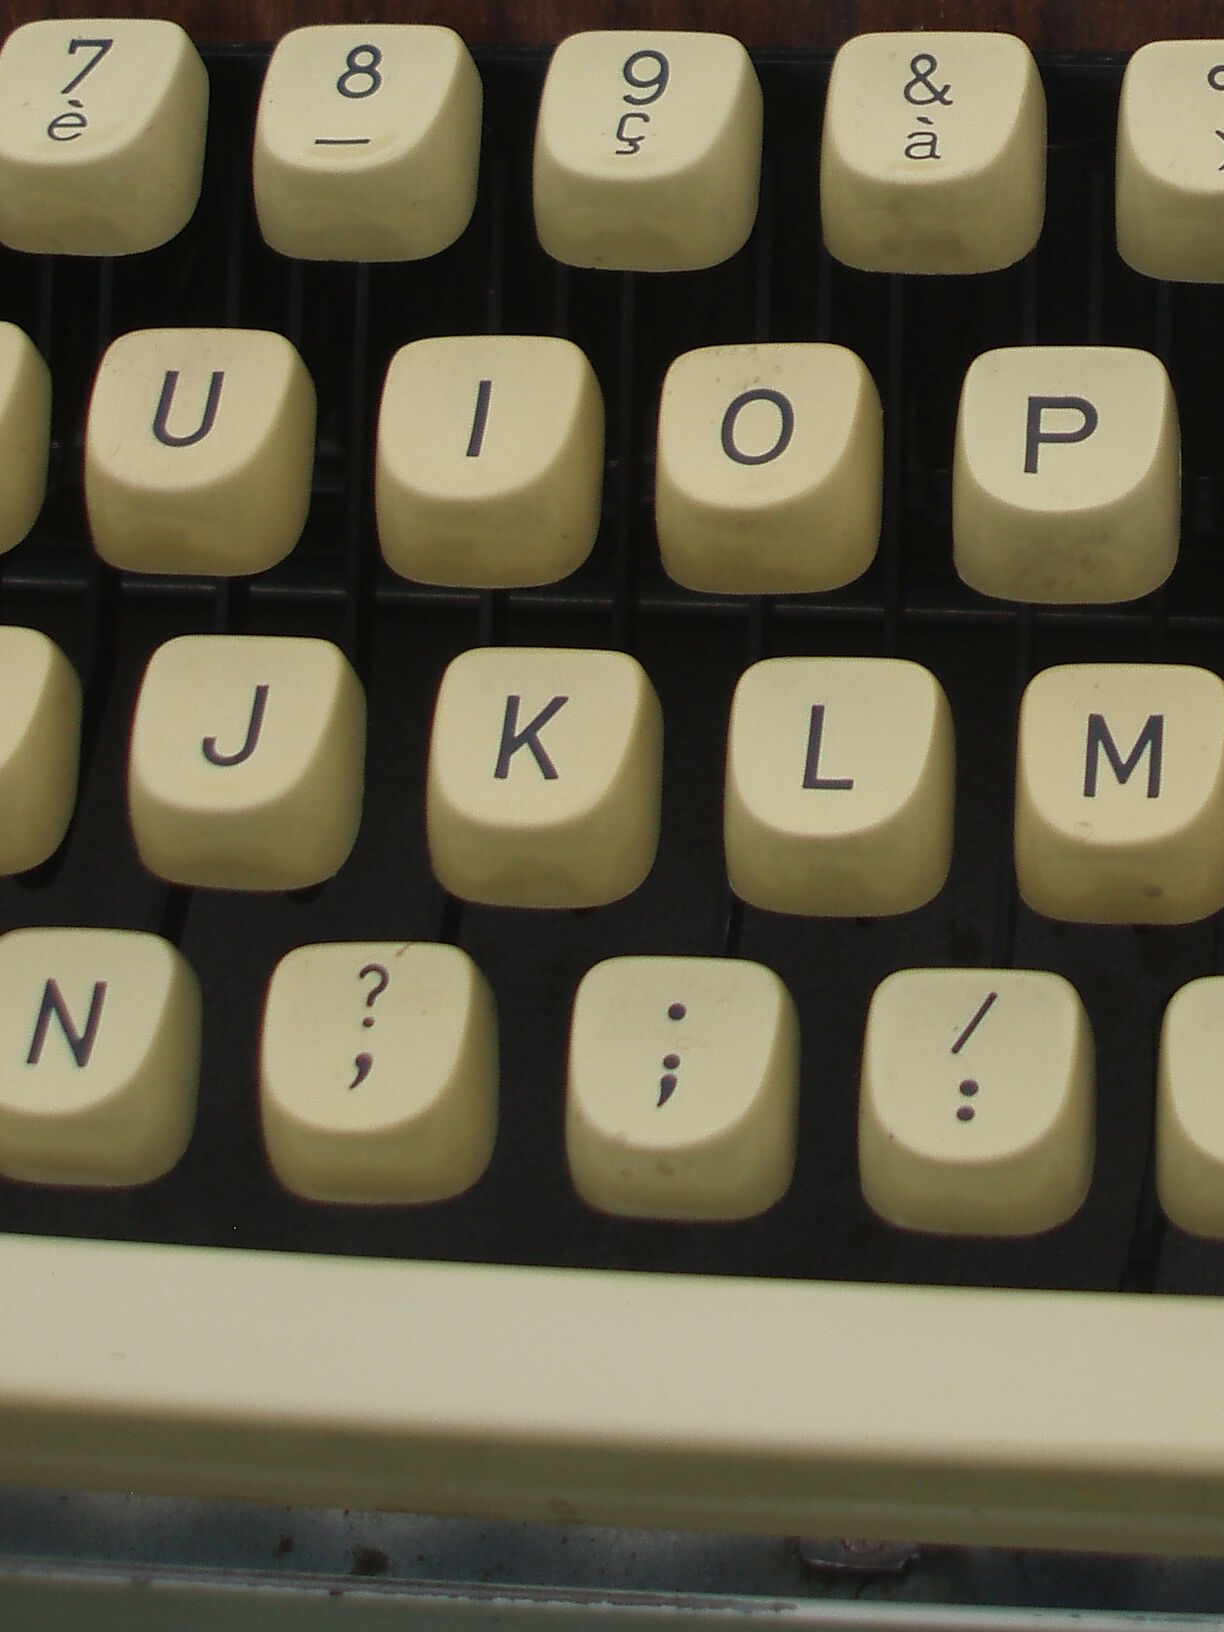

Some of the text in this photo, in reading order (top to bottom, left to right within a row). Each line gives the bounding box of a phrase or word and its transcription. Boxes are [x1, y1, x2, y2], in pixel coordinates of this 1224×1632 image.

[60, 38, 114, 95] 7
[336, 43, 382, 99] 8
[622, 49, 670, 106] 9
[903, 52, 954, 106] &
[46, 99, 88, 142] è
[614, 112, 651, 156] ç
[904, 116, 942, 160] à
[151, 369, 225, 448] U
[465, 379, 493, 458] I
[720, 388, 795, 466] O
[1023, 395, 1099, 475] P
[201, 684, 270, 768] J
[493, 694, 570, 781] K
[801, 704, 854, 791] L
[1083, 713, 1165, 799] M
[25, 978, 108, 1069] N
[357, 963, 390, 1029] ?
[950, 991, 998, 1055] /
